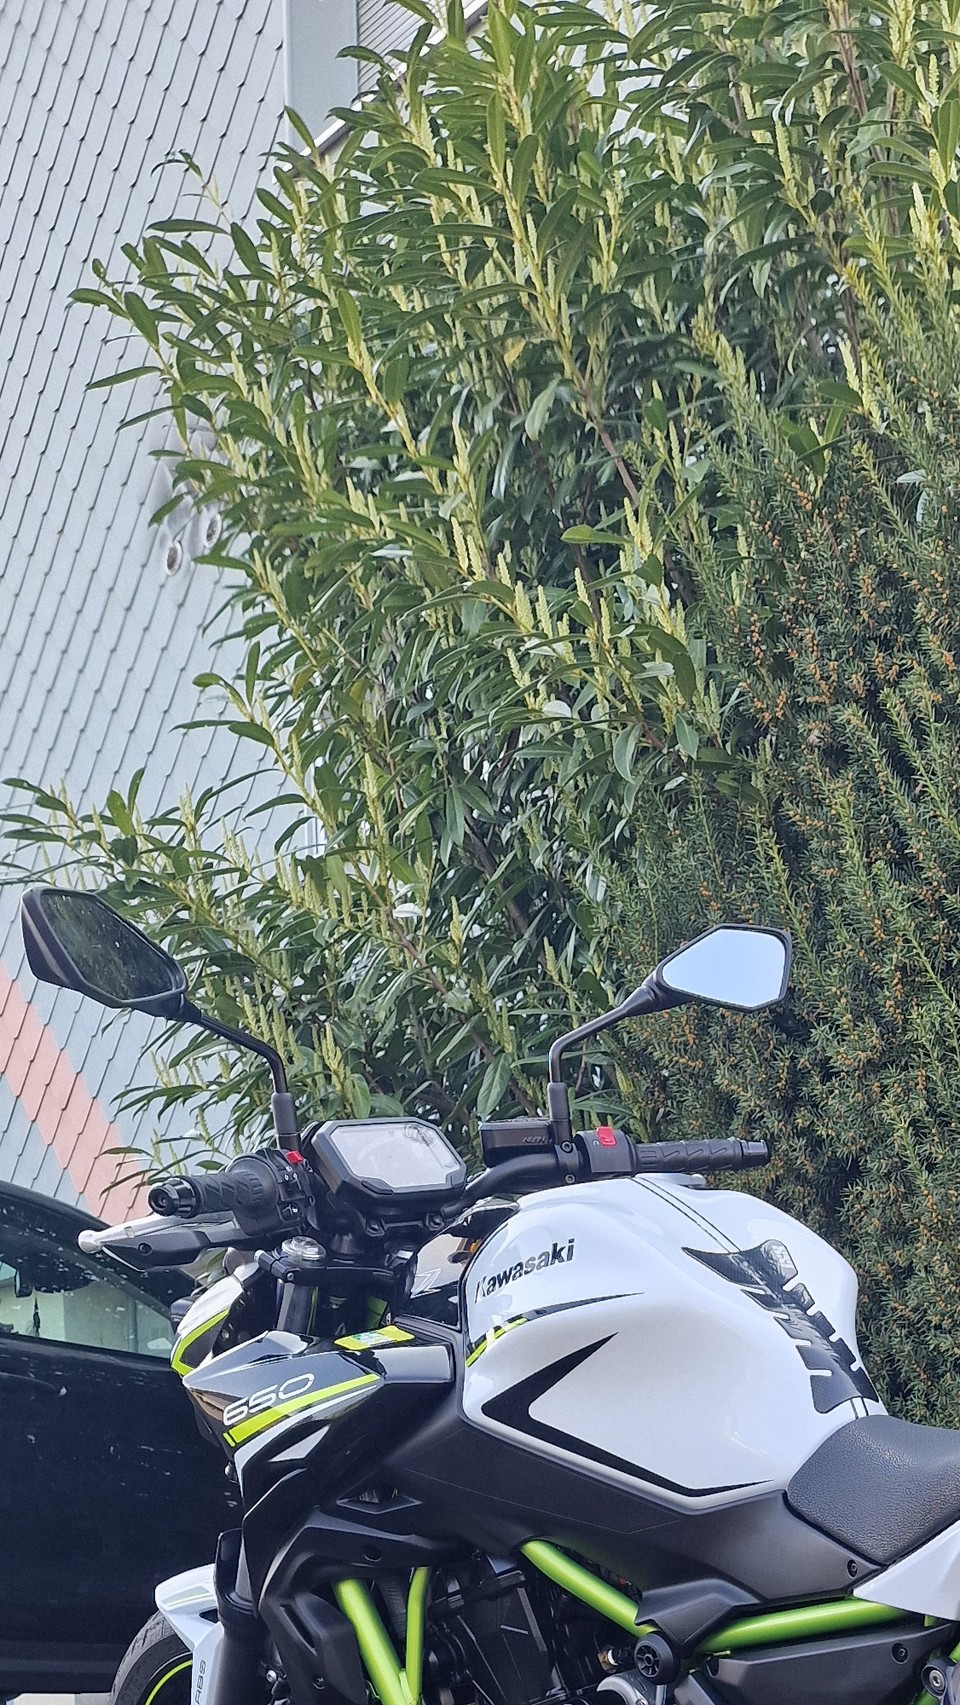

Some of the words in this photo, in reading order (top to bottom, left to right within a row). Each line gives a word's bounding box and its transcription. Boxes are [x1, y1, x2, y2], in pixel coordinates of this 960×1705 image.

[475, 1238, 575, 1304] Kawasaki
[223, 1373, 315, 1426] 650
[195, 1659, 207, 1704] ABS
